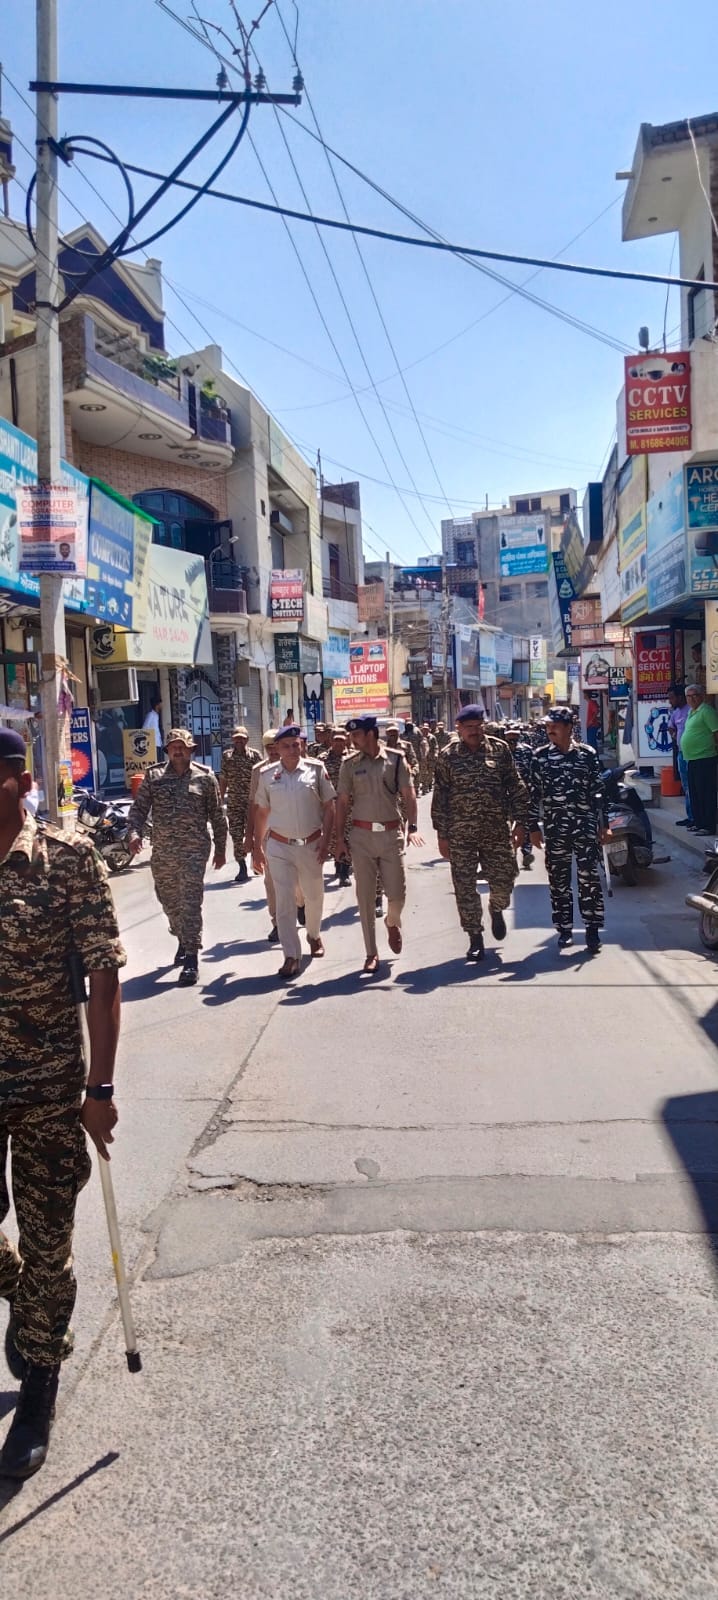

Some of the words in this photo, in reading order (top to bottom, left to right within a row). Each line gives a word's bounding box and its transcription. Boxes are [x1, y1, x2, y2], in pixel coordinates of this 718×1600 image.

[629, 385, 687, 407] CCTV
[630, 407, 687, 420] SERVICES
[21, 500, 74, 509] COMPUTER
[271, 598, 303, 609] S-TECH
[272, 609, 304, 617] INSTITUTE
[353, 663, 385, 674] LAPTOP
